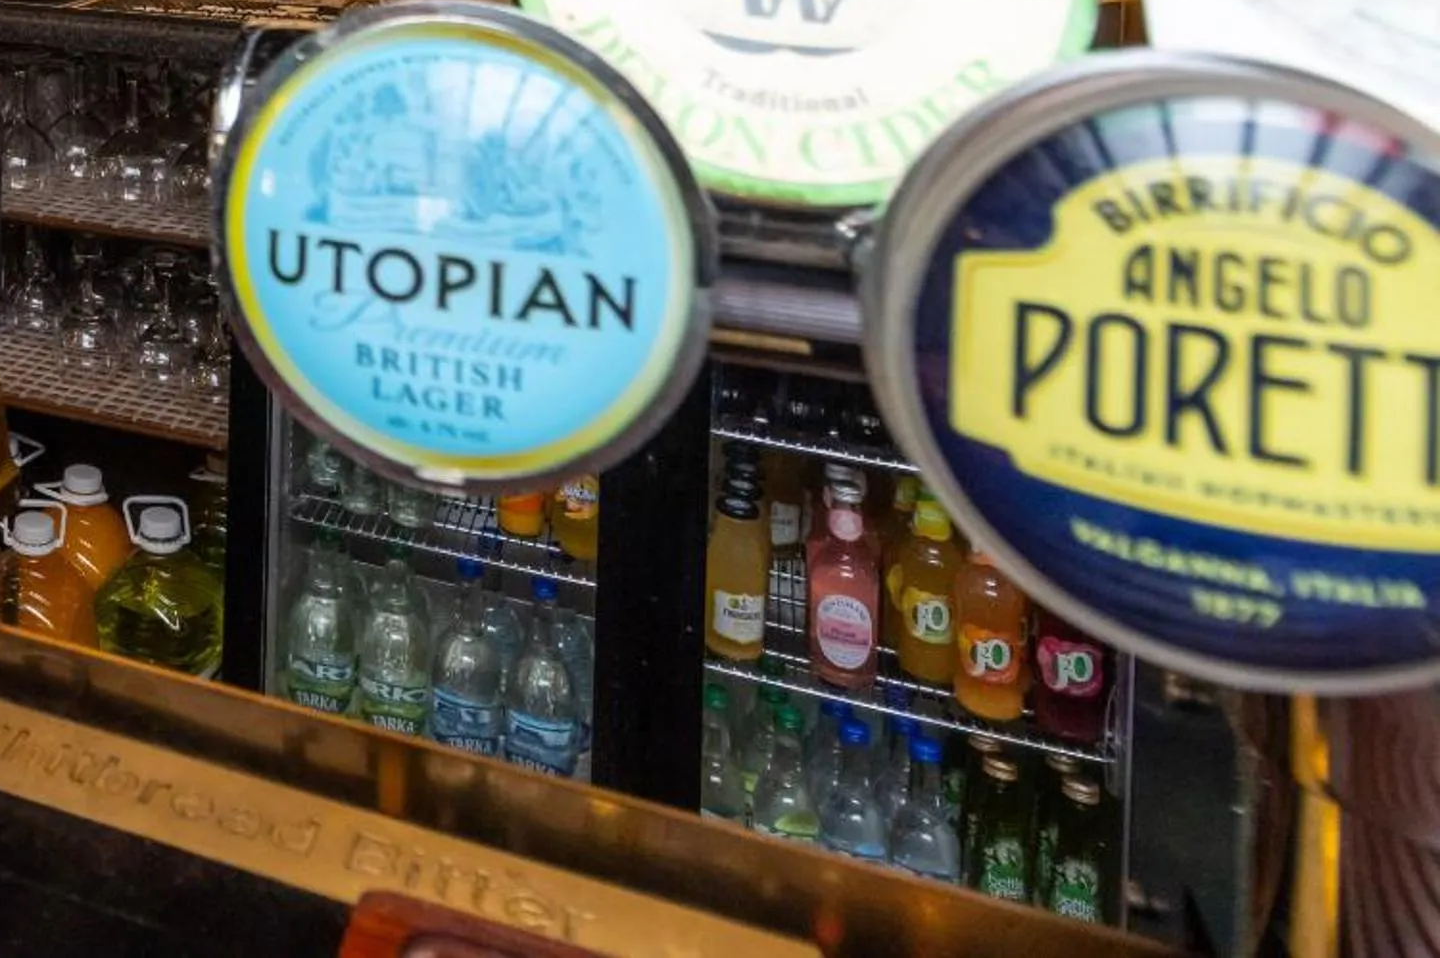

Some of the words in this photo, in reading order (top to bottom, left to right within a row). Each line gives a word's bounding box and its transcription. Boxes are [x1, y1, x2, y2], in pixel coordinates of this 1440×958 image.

[700, 67, 869, 115] Traditional
[797, 57, 1008, 168] CIDER
[268, 228, 640, 334] UTOPIAN
[1122, 244, 1372, 329] ANGELO
[355, 340, 524, 392] BRITISH
[371, 377, 508, 422] LAGER
[296, 690, 339, 712] TARKA
[372, 714, 415, 734] TARKA
[449, 736, 491, 755] TARKA
[344, 830, 598, 941] Bitter
